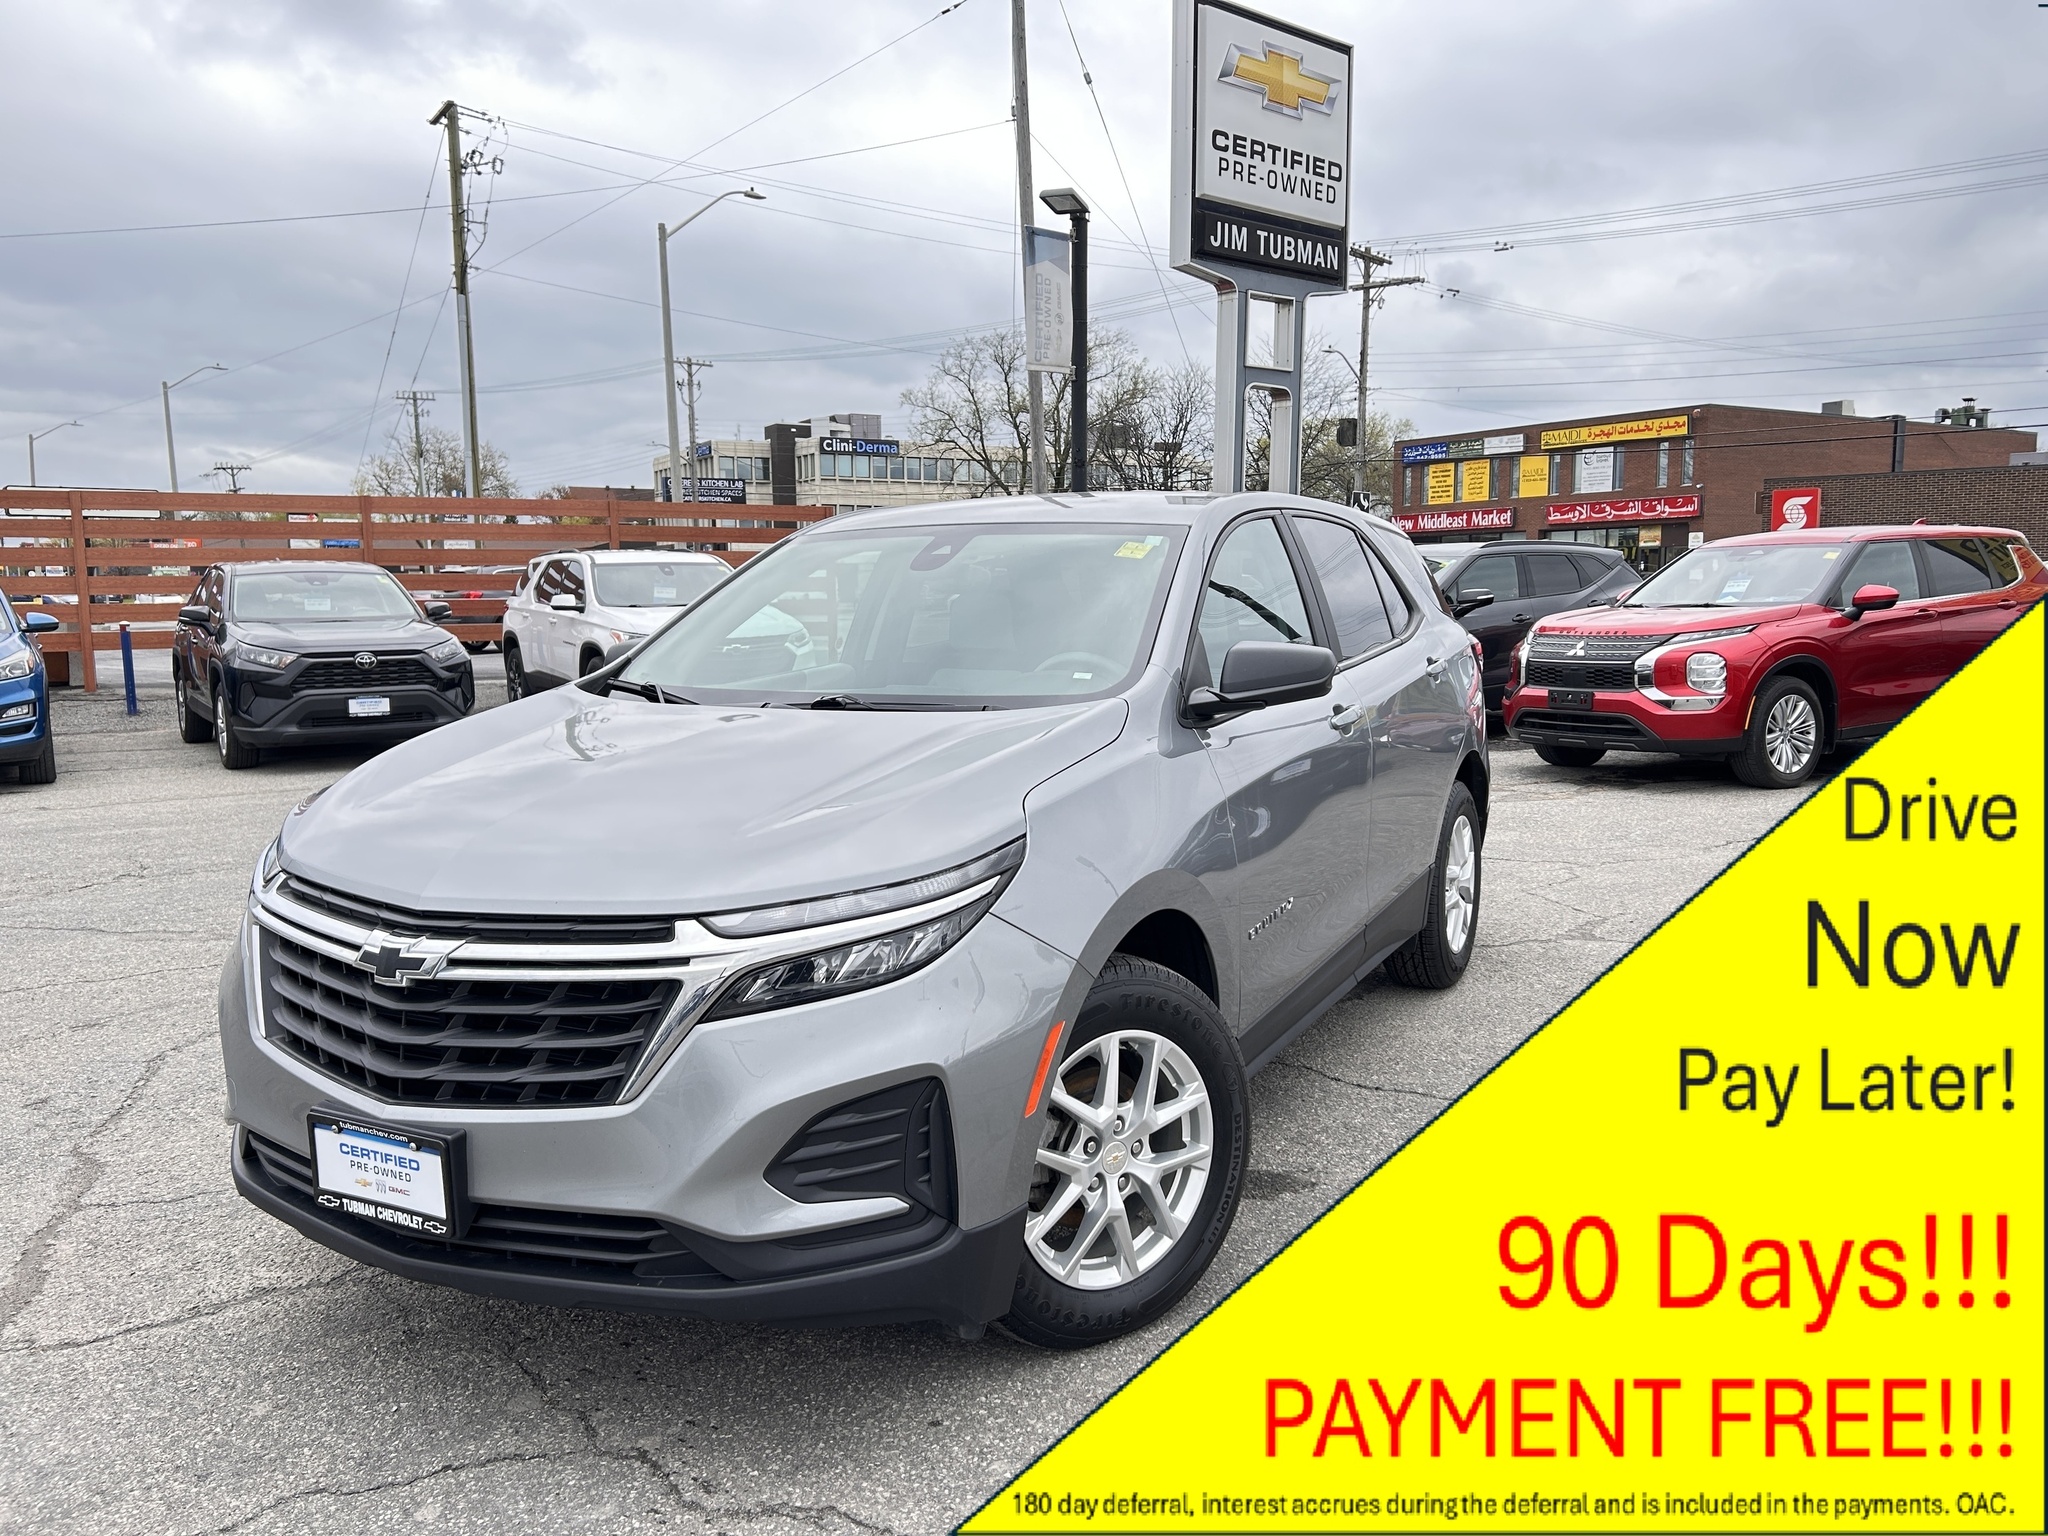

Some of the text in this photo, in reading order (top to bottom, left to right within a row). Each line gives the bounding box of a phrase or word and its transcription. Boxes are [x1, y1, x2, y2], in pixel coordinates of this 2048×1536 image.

[1211, 129, 1343, 183] CERTIFIED
[1218, 156, 1337, 204] PRE-OWNED
[1210, 221, 1339, 270] JIM TUBMAN
[1034, 273, 1044, 362] CERTIFIED
[1043, 278, 1052, 359] PRE-OWNED
[1551, 430, 1581, 443] MAJDI
[1588, 425, 1617, 441] الهجرة
[1655, 420, 1686, 436] مجدي
[822, 439, 898, 454] Clini-Derma
[701, 479, 729, 488] KITCHEN
[730, 480, 743, 488] LAB
[1391, 509, 1512, 531] New Middleast Market
[1118, 991, 1223, 1058] Firestone
[339, 1121, 409, 1143] tubmanchev.com
[339, 1142, 420, 1172] CERTIFIED
[1216, 1112, 1242, 1224] DESTINATION
[350, 1159, 412, 1183] PRE-OWNED
[388, 1186, 410, 1196] GMC
[342, 1198, 423, 1230] TUBMAN CHEVROLET
